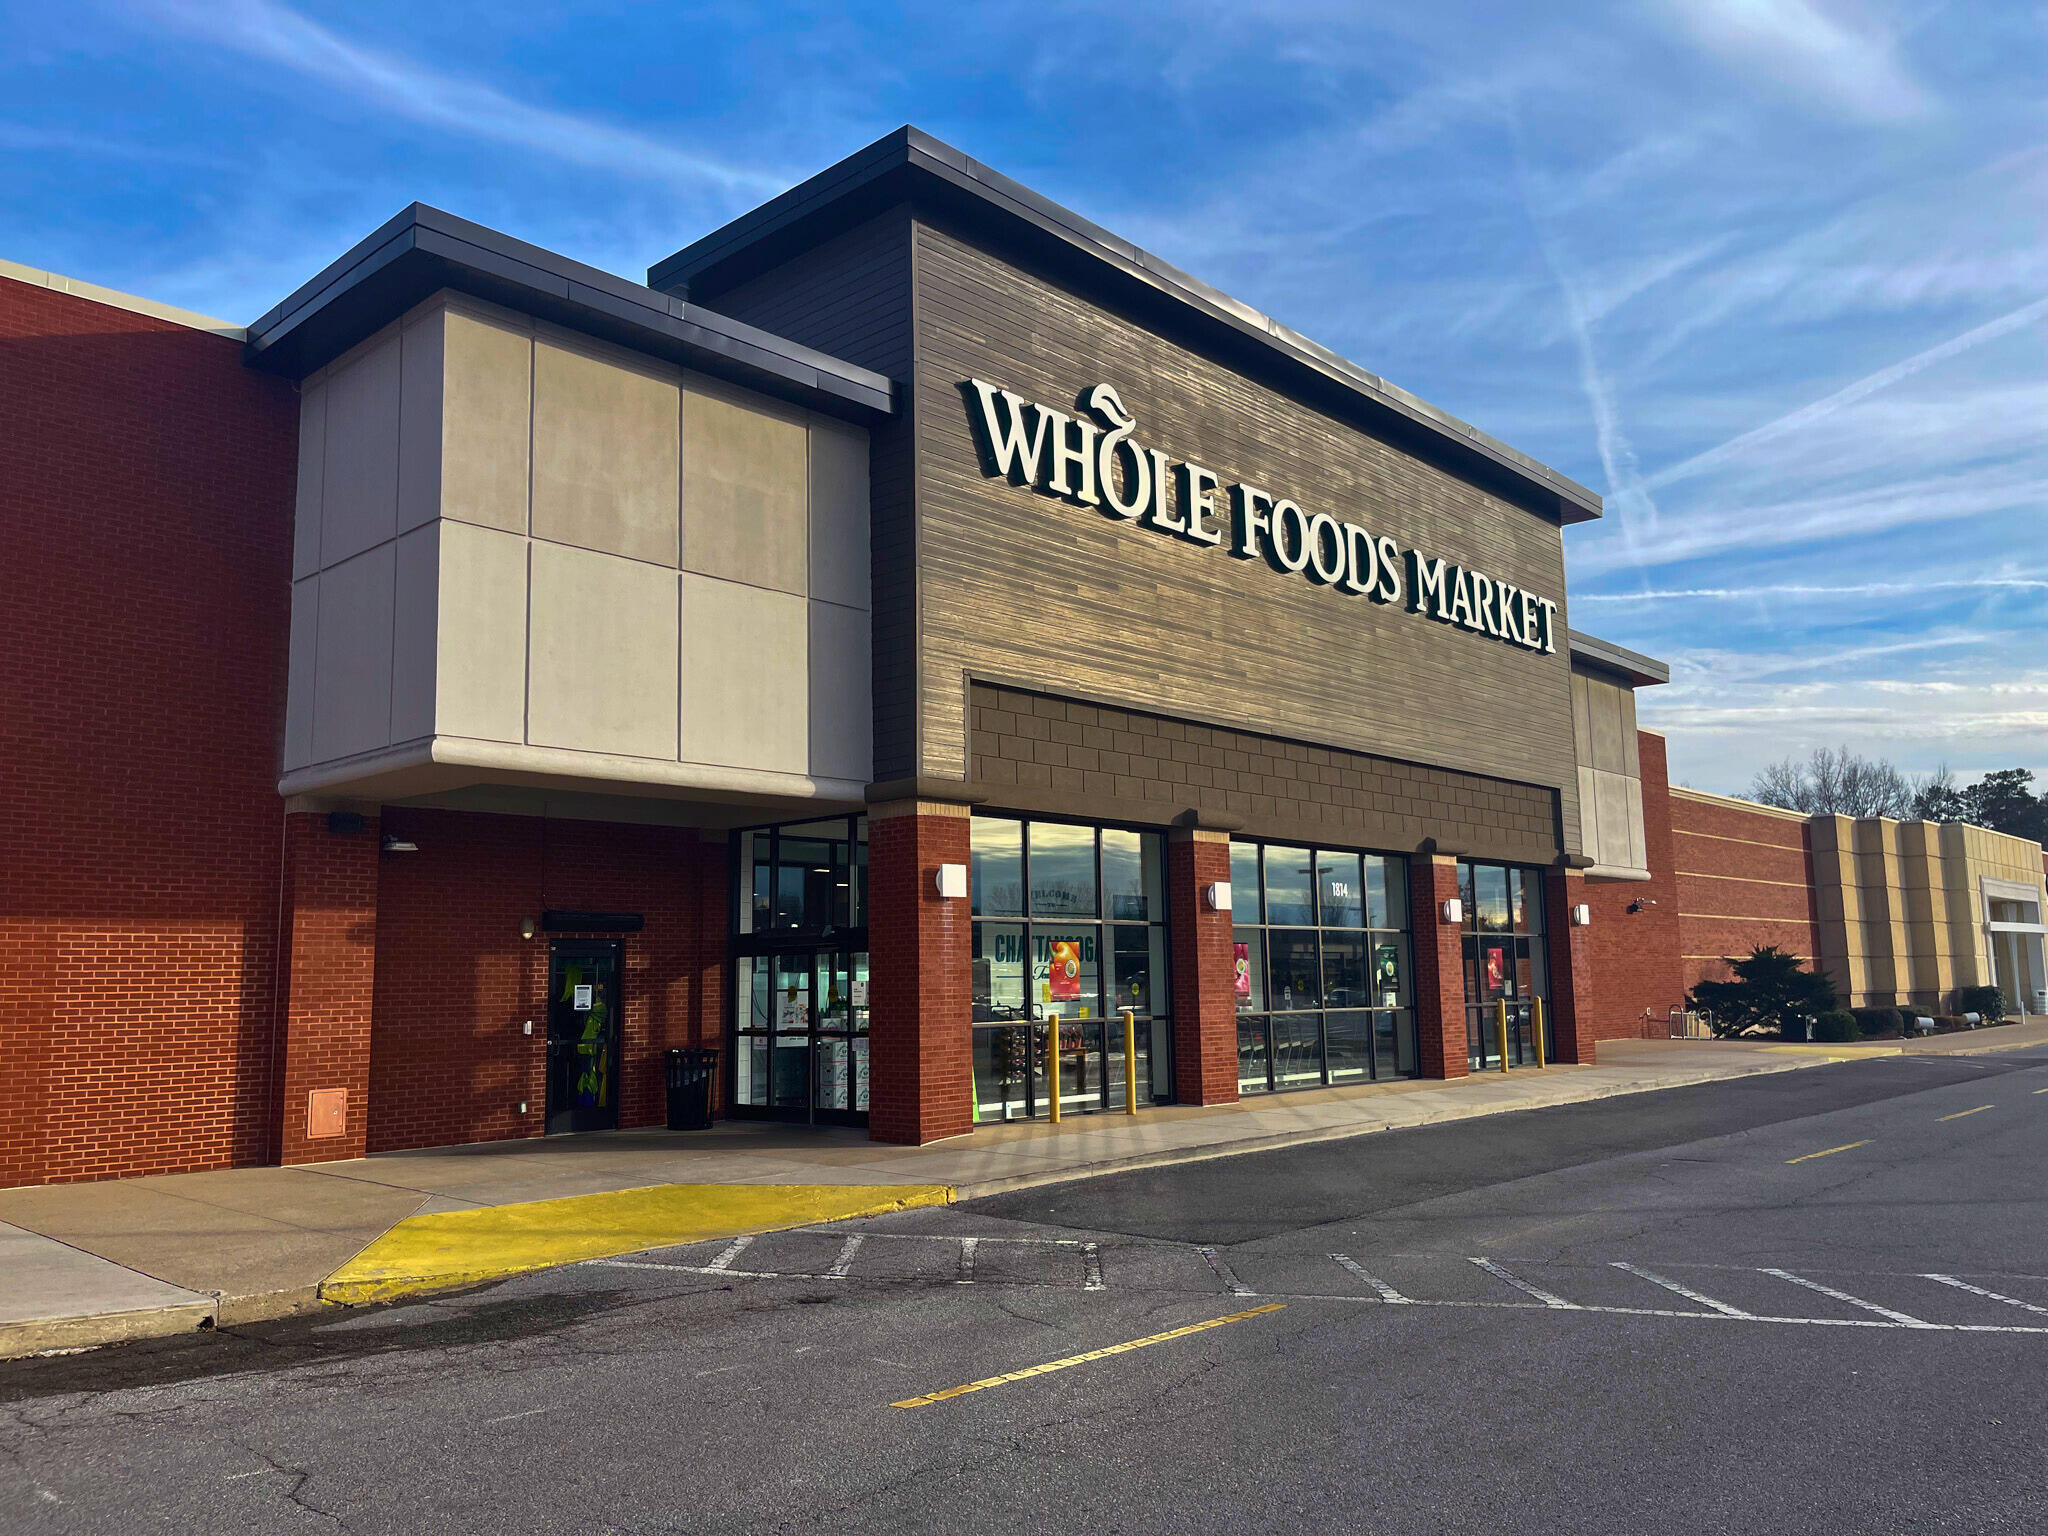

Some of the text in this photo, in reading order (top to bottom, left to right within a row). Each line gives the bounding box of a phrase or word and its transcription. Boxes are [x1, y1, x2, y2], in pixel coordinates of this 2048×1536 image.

[969, 377, 1558, 655] WHOLE FOODS MARKET
[1030, 889, 1077, 904] ELCOME
[1331, 881, 1348, 897] 1814
